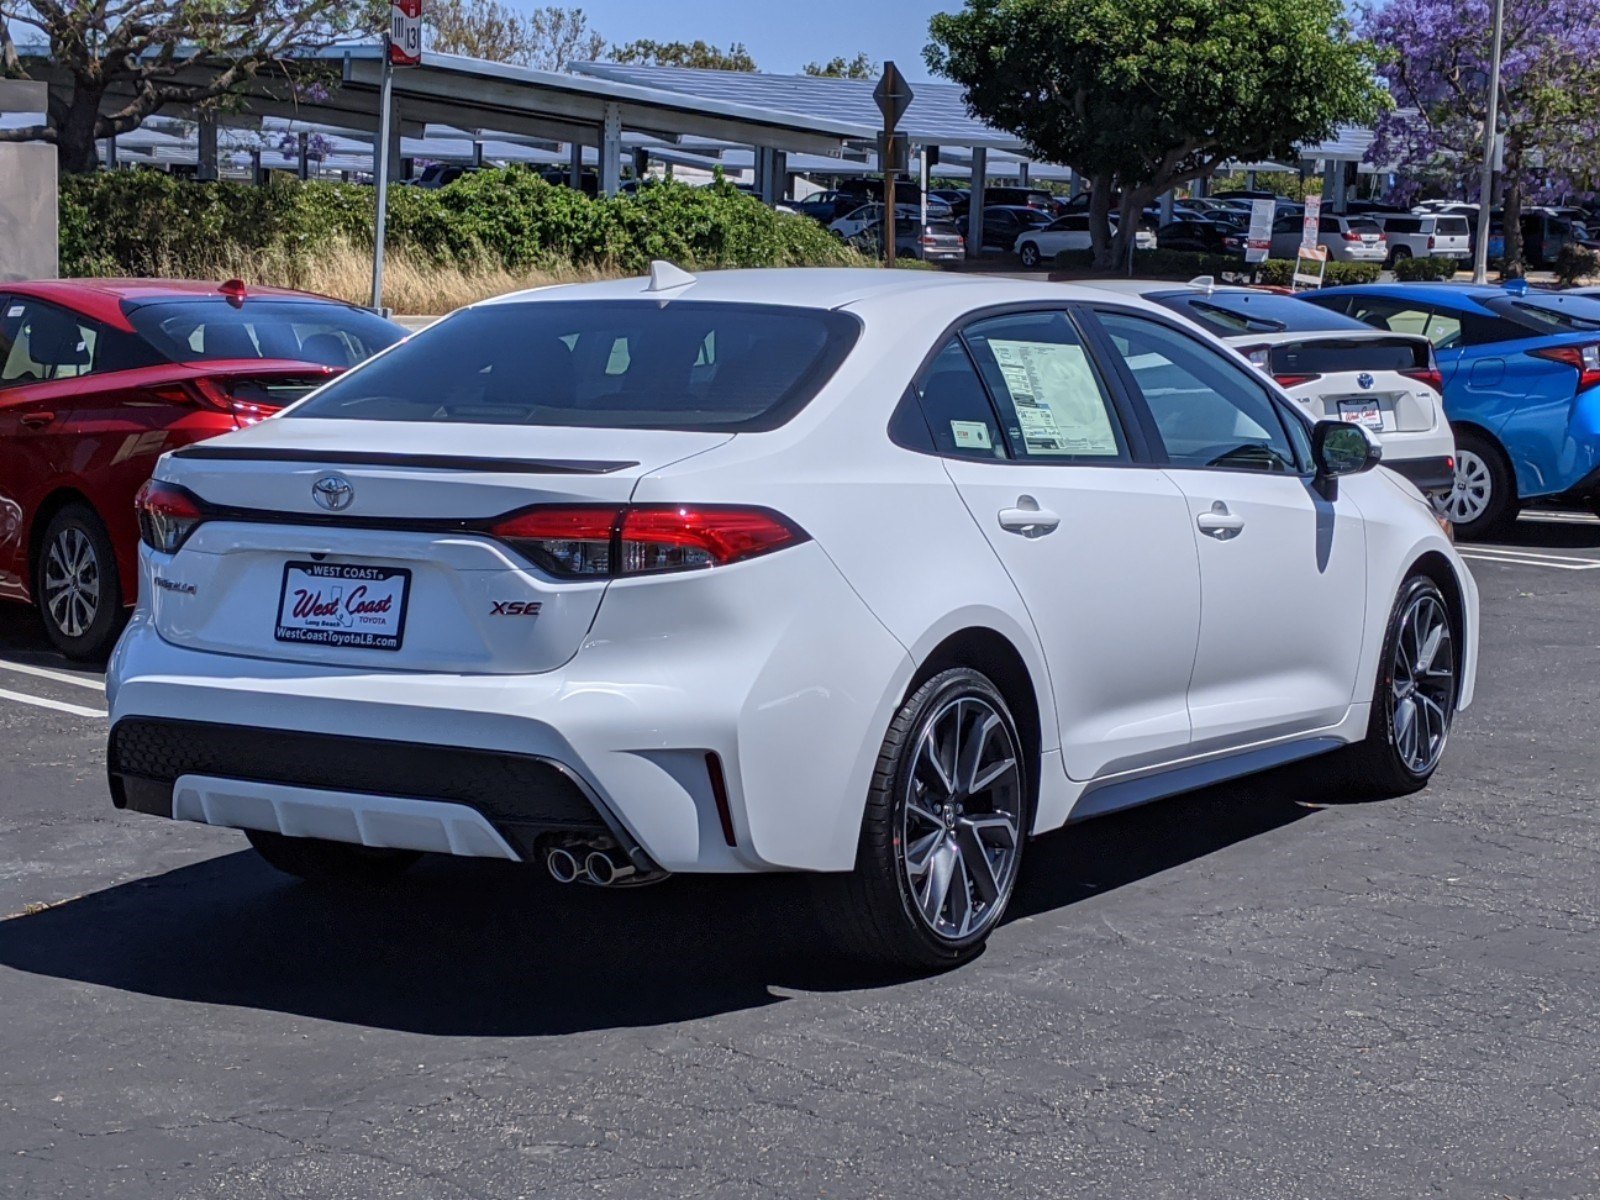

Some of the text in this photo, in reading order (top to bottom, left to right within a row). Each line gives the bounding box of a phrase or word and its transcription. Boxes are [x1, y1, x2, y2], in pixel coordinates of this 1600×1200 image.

[394, 17, 404, 38] 111
[407, 27, 420, 49] 131
[313, 565, 379, 580] WEST COAST
[293, 584, 393, 618] West Coast
[490, 600, 543, 616] XSE
[359, 616, 386, 625] TOYOTA
[276, 627, 397, 647] WestCoastToyotaLB.com
